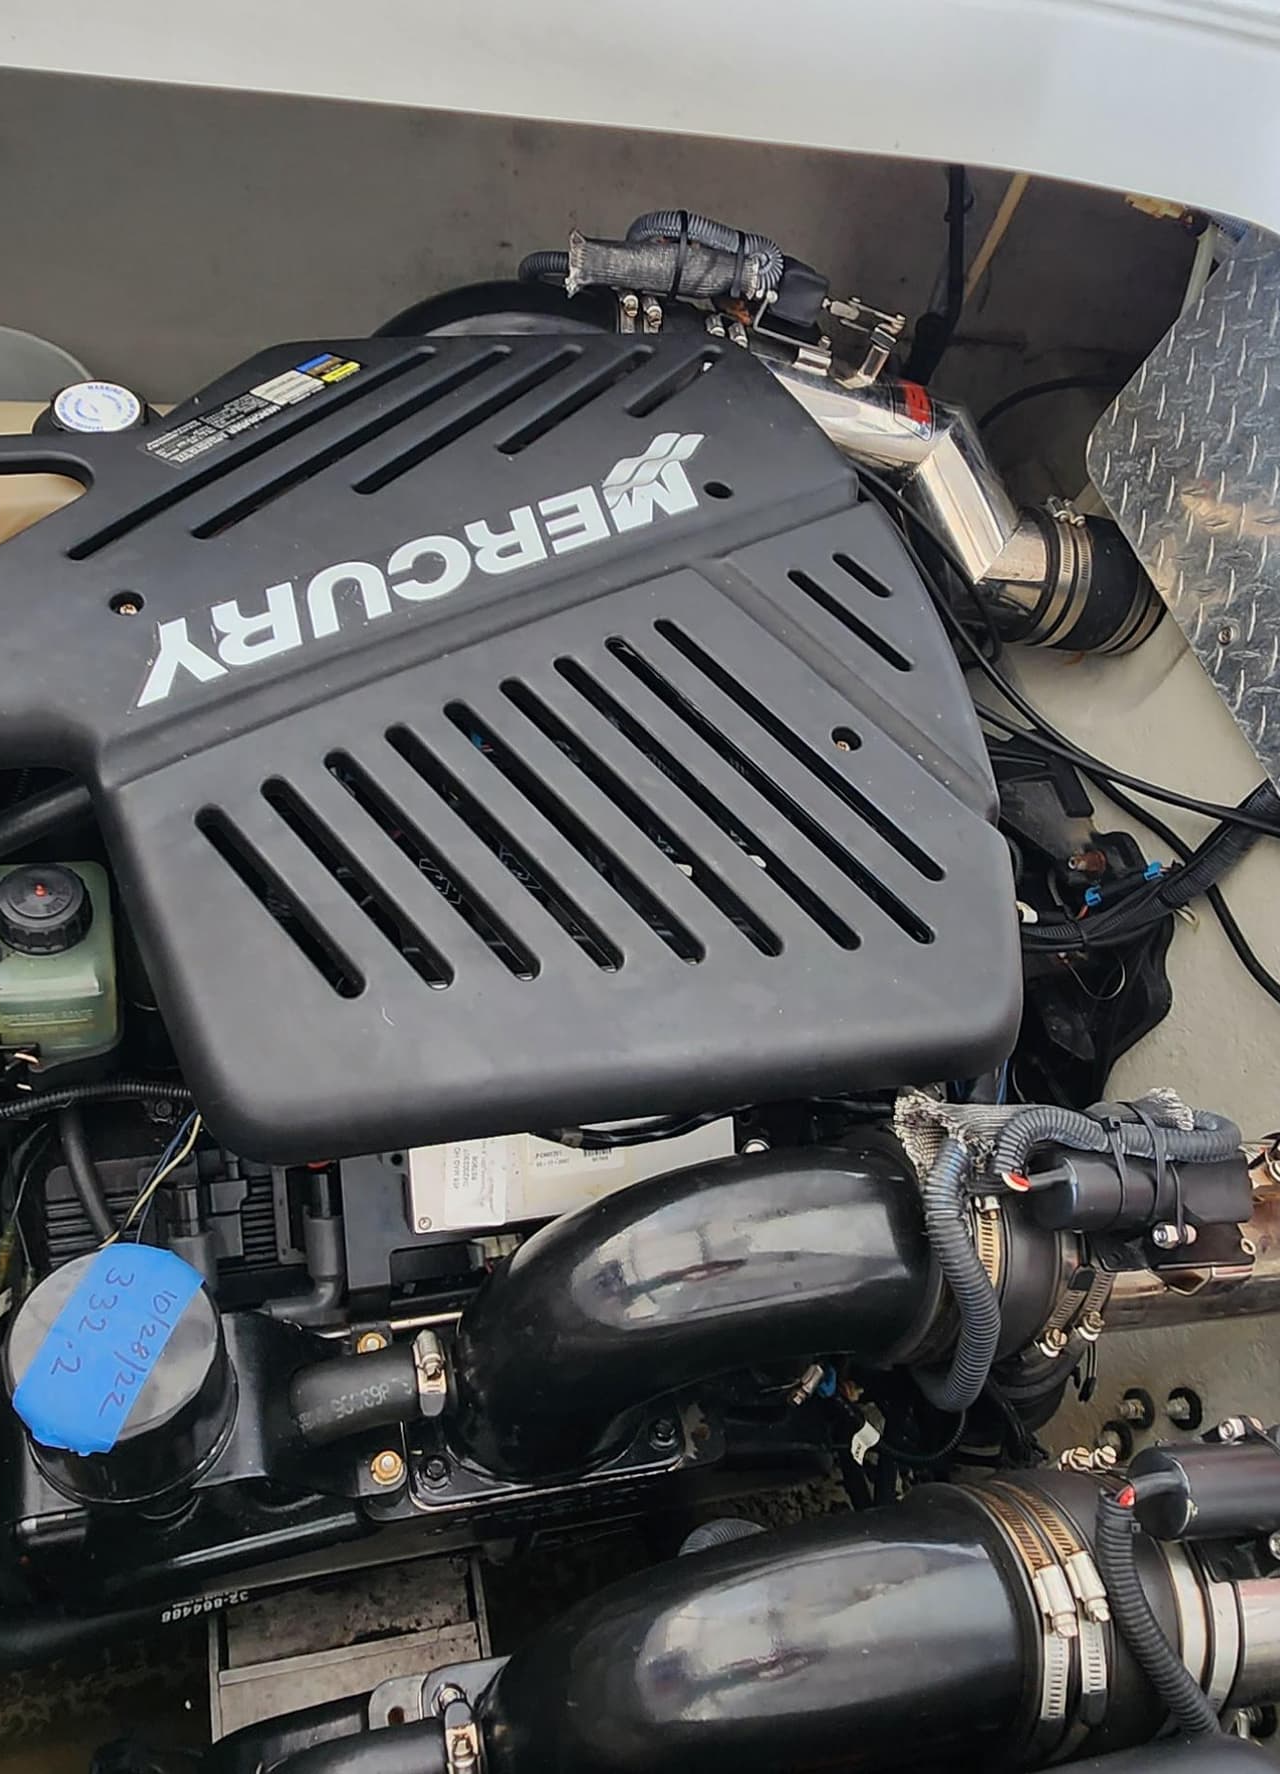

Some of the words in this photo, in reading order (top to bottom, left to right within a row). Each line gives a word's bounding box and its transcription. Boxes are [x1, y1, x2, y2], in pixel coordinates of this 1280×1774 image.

[137, 462, 699, 708] MERCURY
[50, 1267, 135, 1375] 332.2
[98, 1290, 178, 1417] 10/28/22
